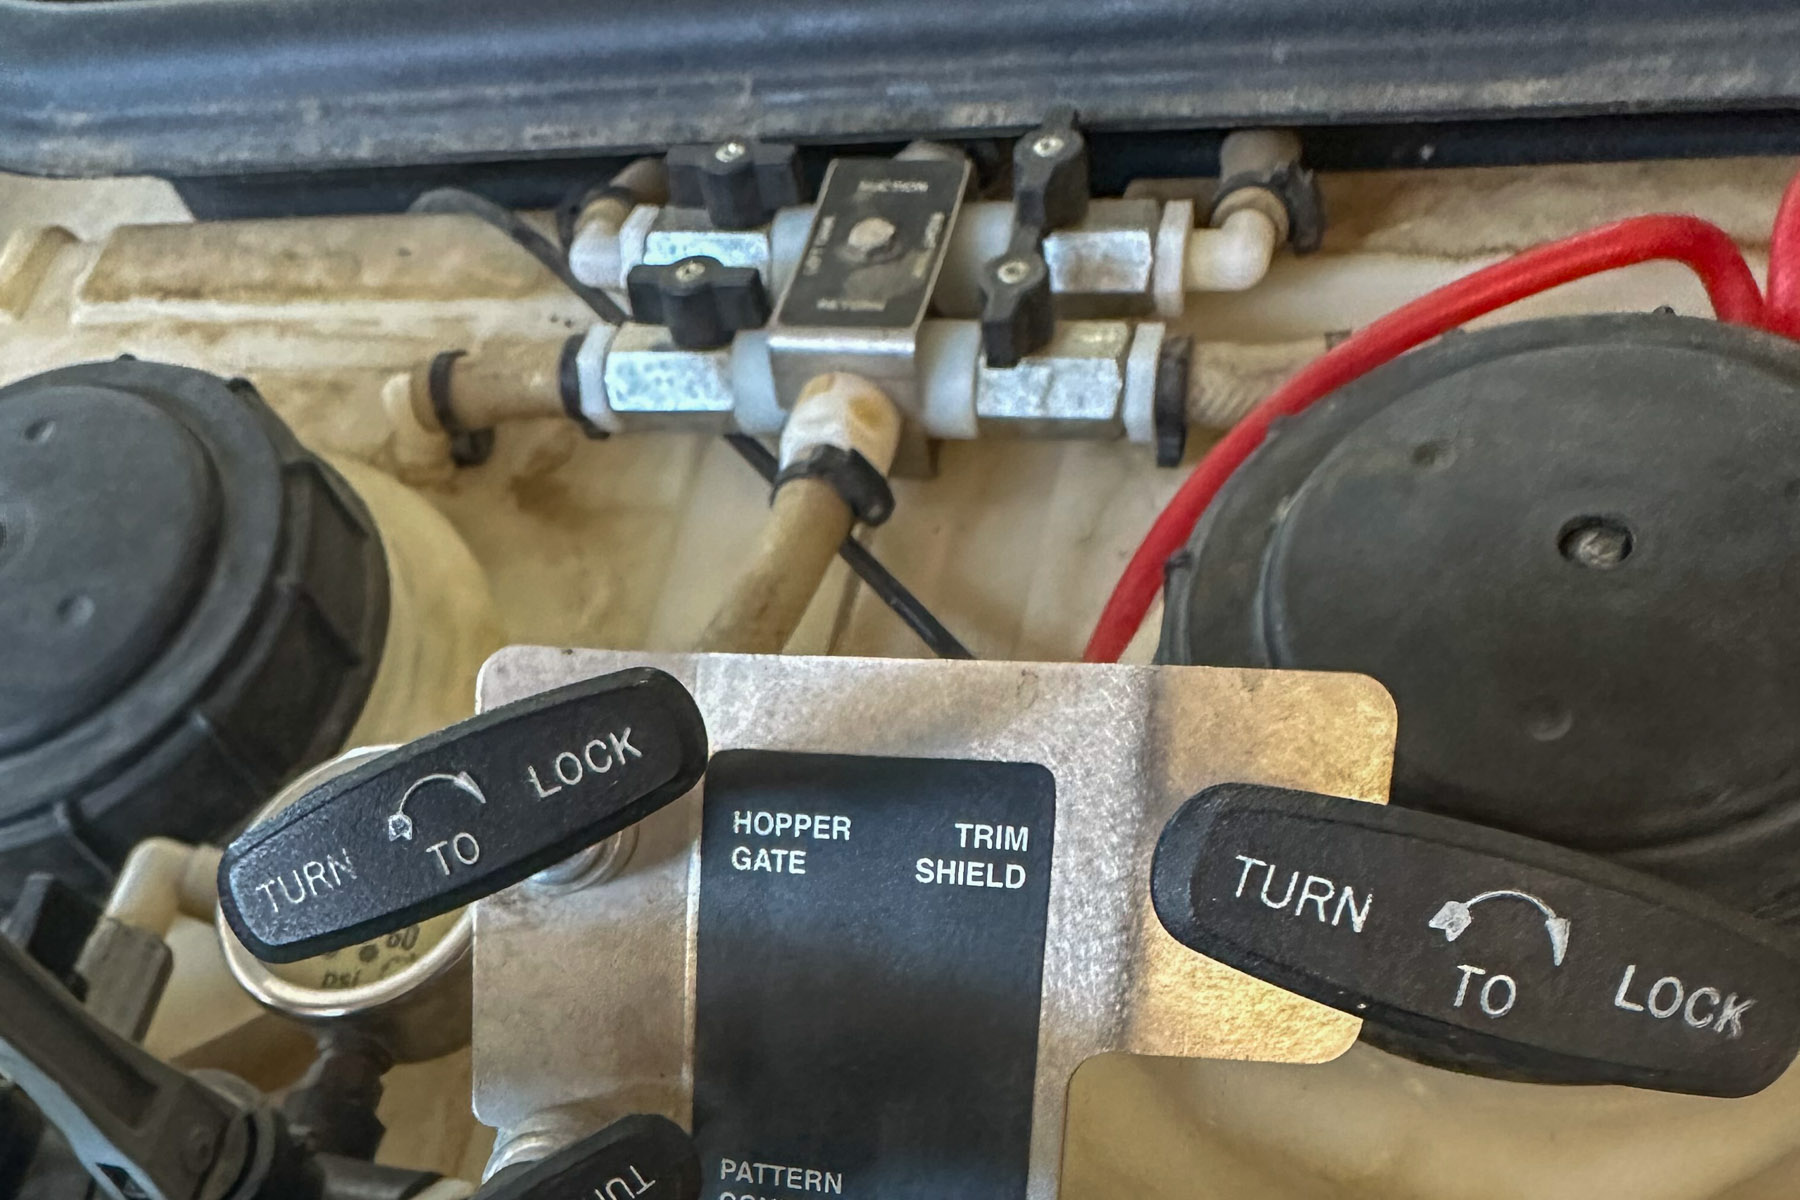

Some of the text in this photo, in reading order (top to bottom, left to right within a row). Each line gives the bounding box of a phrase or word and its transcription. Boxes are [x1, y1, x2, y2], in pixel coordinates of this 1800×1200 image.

[255, 726, 643, 914] TURN TO LOCK
[733, 811, 851, 841] HOPPER
[955, 822, 1029, 852] TRIM
[731, 846, 806, 875] GATE
[915, 858, 1026, 889] SHIELD
[1235, 855, 1757, 1039] TURN TO LOCK
[720, 1157, 843, 1195] PATTERN
